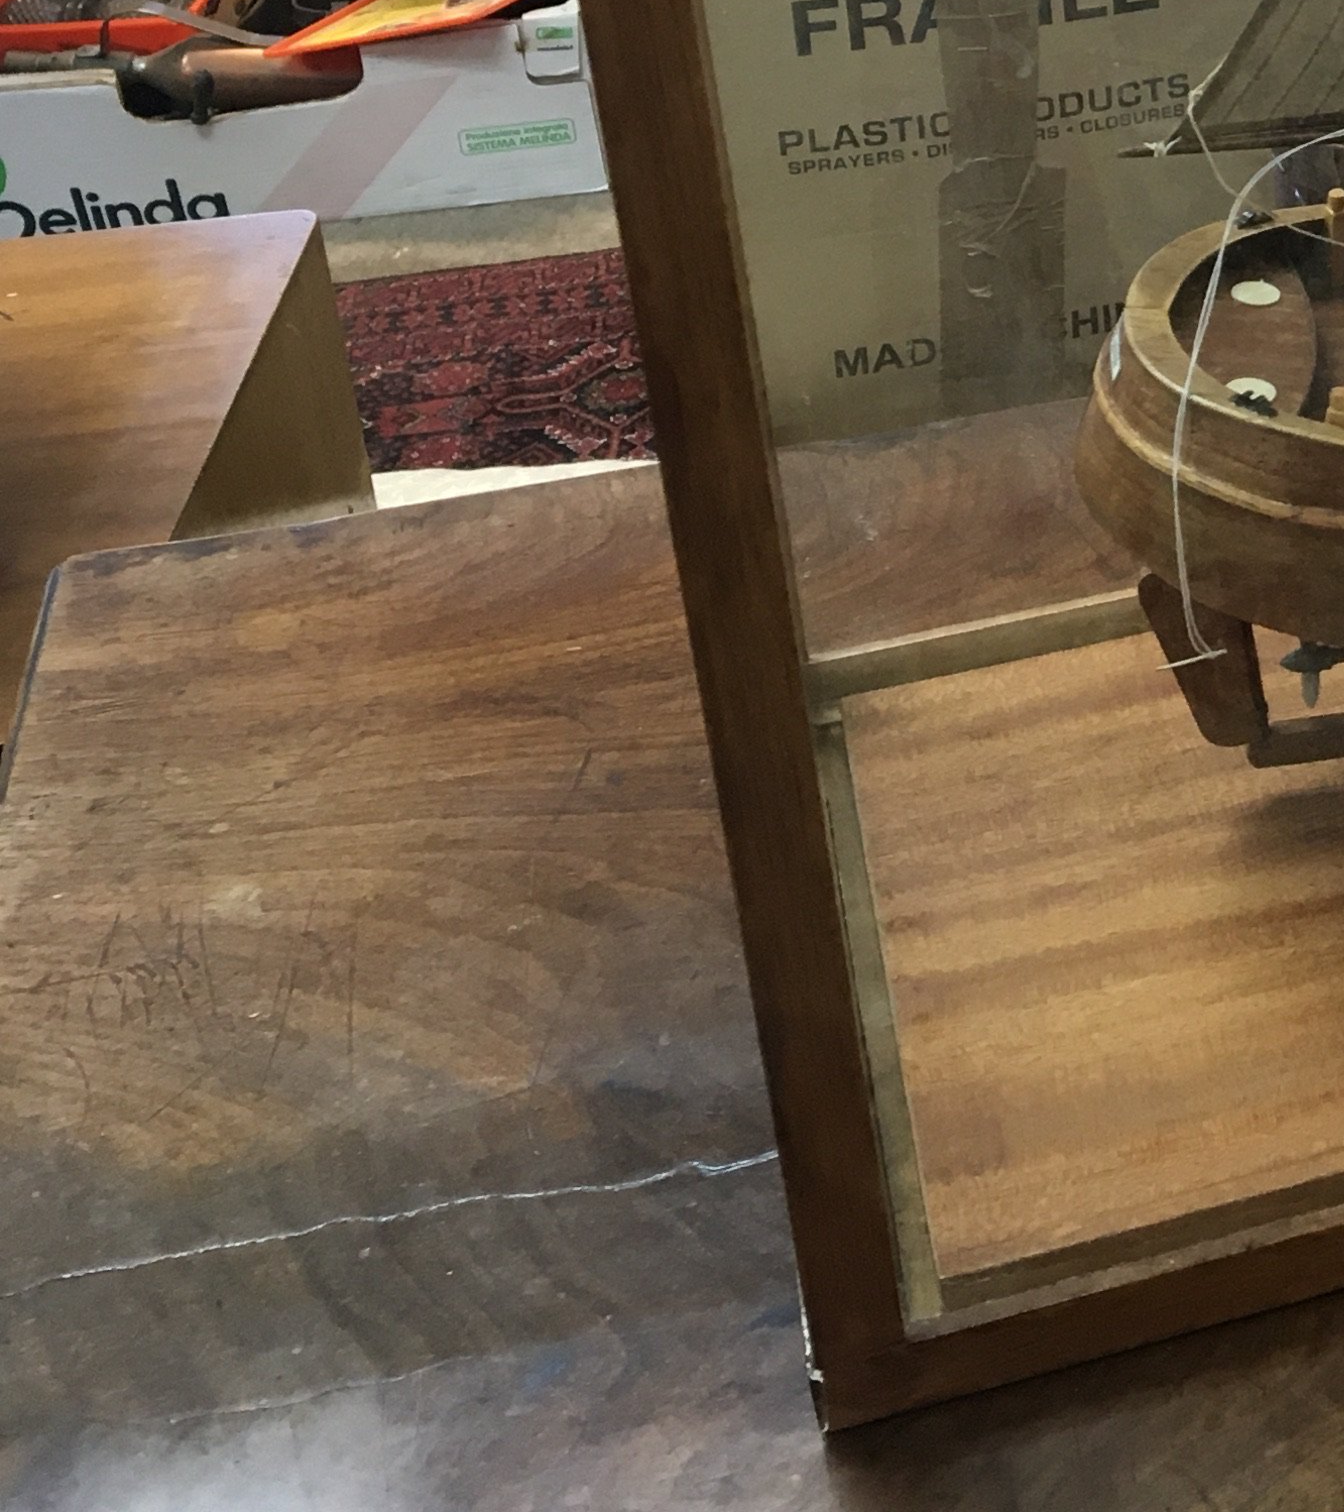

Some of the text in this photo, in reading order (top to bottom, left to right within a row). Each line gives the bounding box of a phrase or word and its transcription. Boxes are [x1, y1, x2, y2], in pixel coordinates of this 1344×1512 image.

[466, 131, 572, 153] SISTEMA MELINDA
[788, 103, 1186, 175] SPRAYERS CLOSURES
[834, 337, 937, 379] MAD
